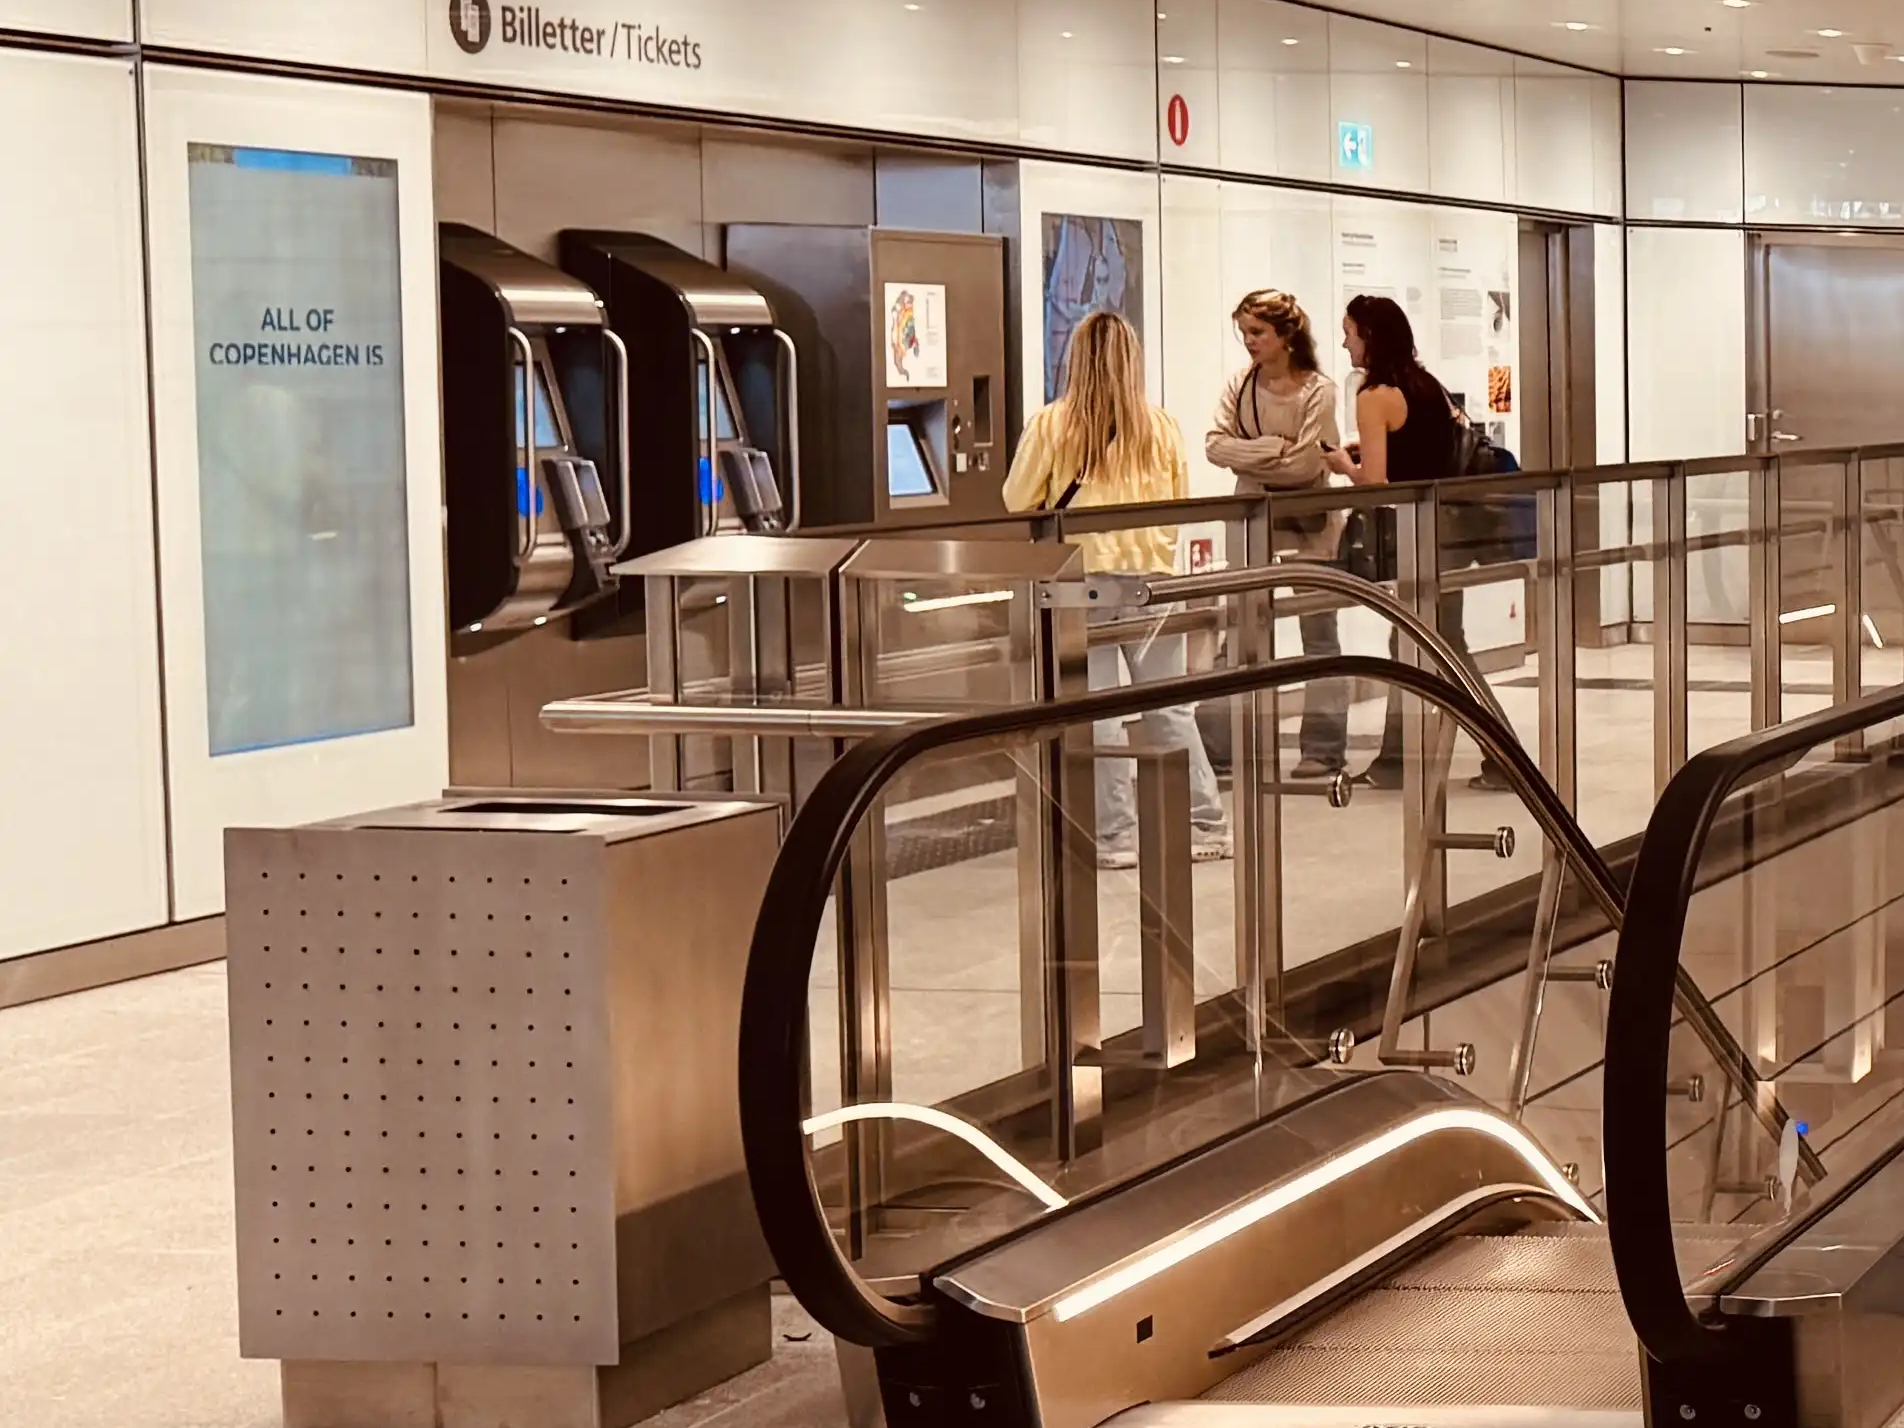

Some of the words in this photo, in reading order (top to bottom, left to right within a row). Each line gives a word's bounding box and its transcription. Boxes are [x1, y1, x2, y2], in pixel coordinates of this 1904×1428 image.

[261, 307, 300, 332] ALL
[306, 309, 335, 332] OF
[209, 343, 359, 366] COPENHAGEN
[366, 345, 384, 366] IS
